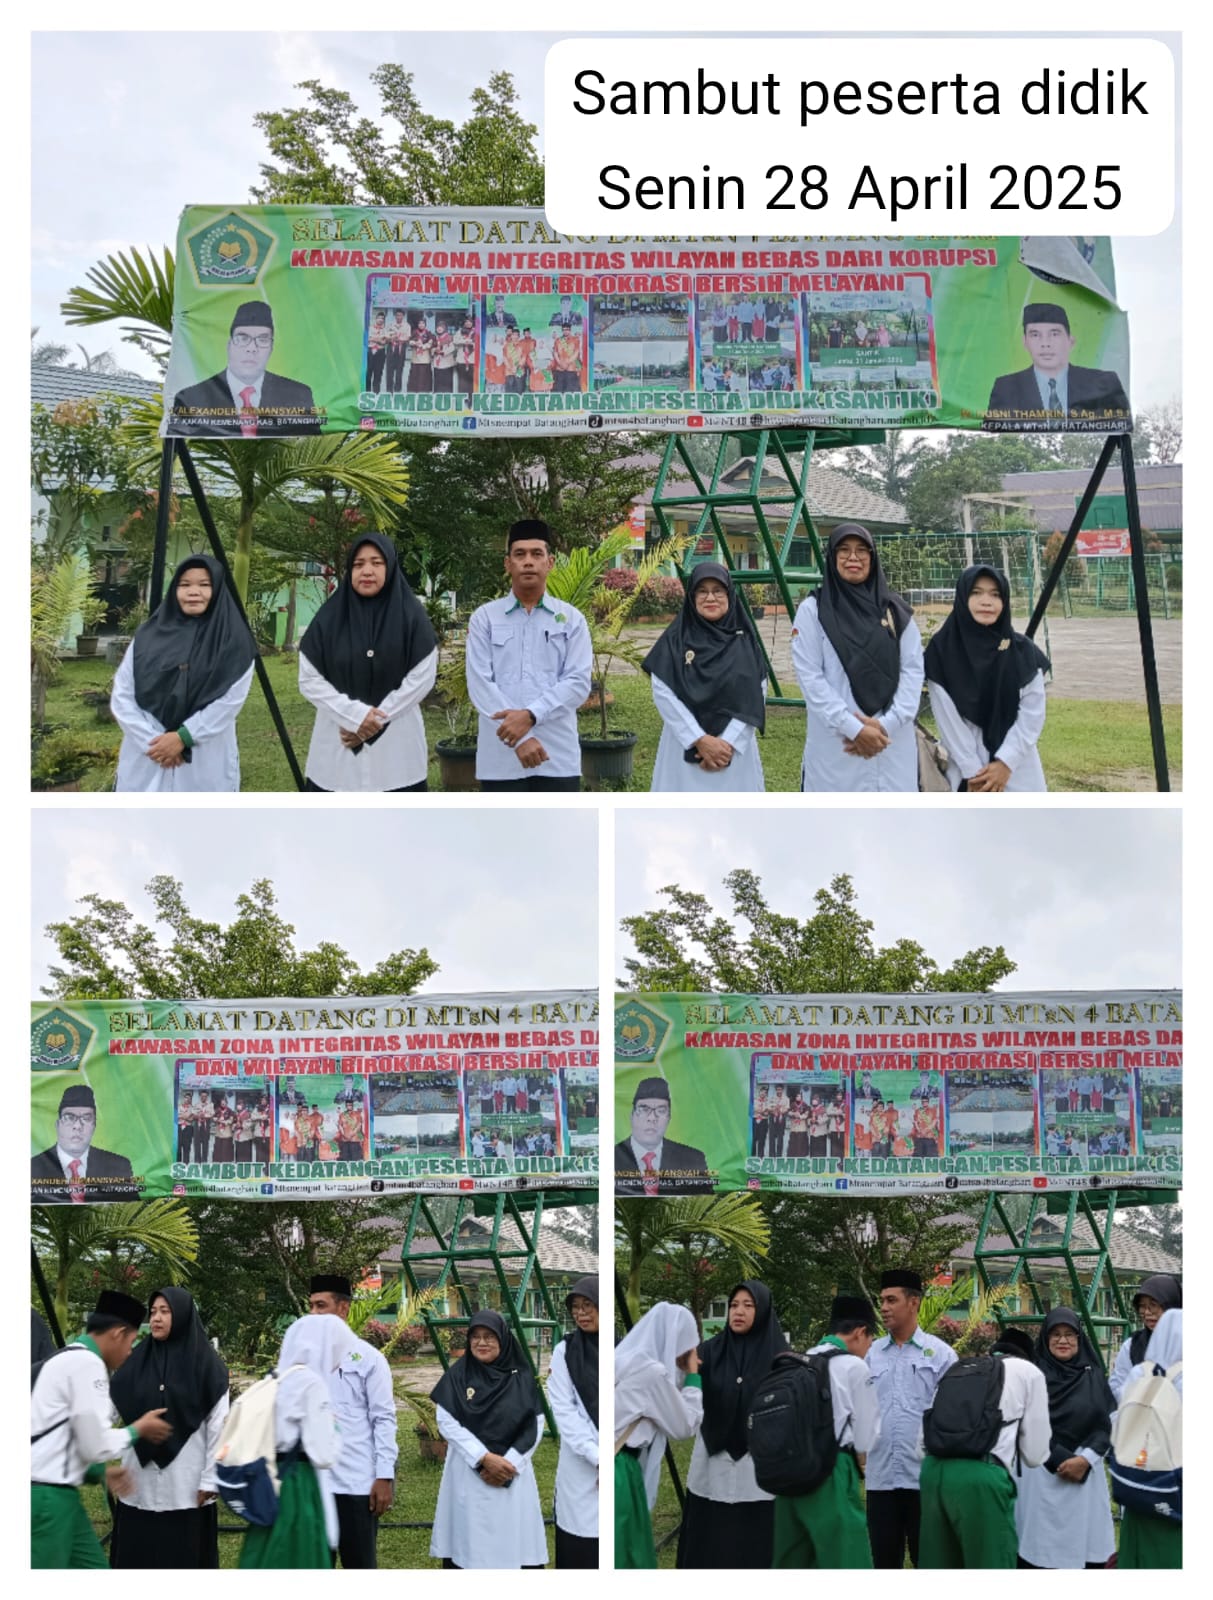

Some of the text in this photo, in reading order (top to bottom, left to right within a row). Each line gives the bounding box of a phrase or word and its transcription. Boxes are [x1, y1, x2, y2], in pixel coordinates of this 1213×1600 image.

[292, 218, 451, 243] SELAMAT
[459, 221, 598, 244] DATA
[290, 248, 998, 269] KAWASAN ZONA INTEGRITAS WILAYAH BEBAS DARI KORUPSI
[390, 273, 905, 294] DAN WILAYAH BIROKRASI BERSIH MELAYANI
[358, 390, 939, 412] SAMBUT KEDATANGAN PESERTA DIDIK (SANTIK)
[981, 421, 1021, 431] KEPALA
[109, 1009, 248, 1033] SELAMAT
[253, 1008, 376, 1031] DATANG
[384, 1007, 417, 1028] DI
[426, 1005, 500, 1027] MTsN
[507, 1006, 523, 1025] 4
[685, 1002, 1183, 1026] SELAMAT DATANG DI MTsN 4 BATA
[109, 1038, 215, 1055] KAWASAN
[220, 1038, 275, 1054] ZONA
[279, 1035, 402, 1053] INTEGRITAS
[405, 1033, 500, 1050] WILAYAH
[505, 1030, 575, 1048] BEBAS
[684, 1030, 1183, 1049] KAWASAN ZONA INTEGRITAS WILAYAH BEBAS DA
[195, 1060, 238, 1076] DAN
[243, 1058, 336, 1075] WILAYAH
[342, 1055, 459, 1074] BIROKRASI
[464, 1053, 544, 1070] BERSIH
[771, 1054, 815, 1070] DAN
[819, 1053, 912, 1070] WILAYAH
[917, 1053, 1034, 1070] BIROKRASI
[1040, 1051, 1119, 1069] BERSIH
[171, 1161, 265, 1179] SAMBUT
[269, 1159, 409, 1179] KEDATANGAN
[414, 1157, 509, 1175] PESERTA
[514, 1156, 577, 1174] DIDIK
[745, 1157, 839, 1174] SAMBUT
[844, 1156, 986, 1174] KEDATANGAN
[989, 1155, 1083, 1173] PESERTA
[1087, 1155, 1151, 1172] DIDIK
